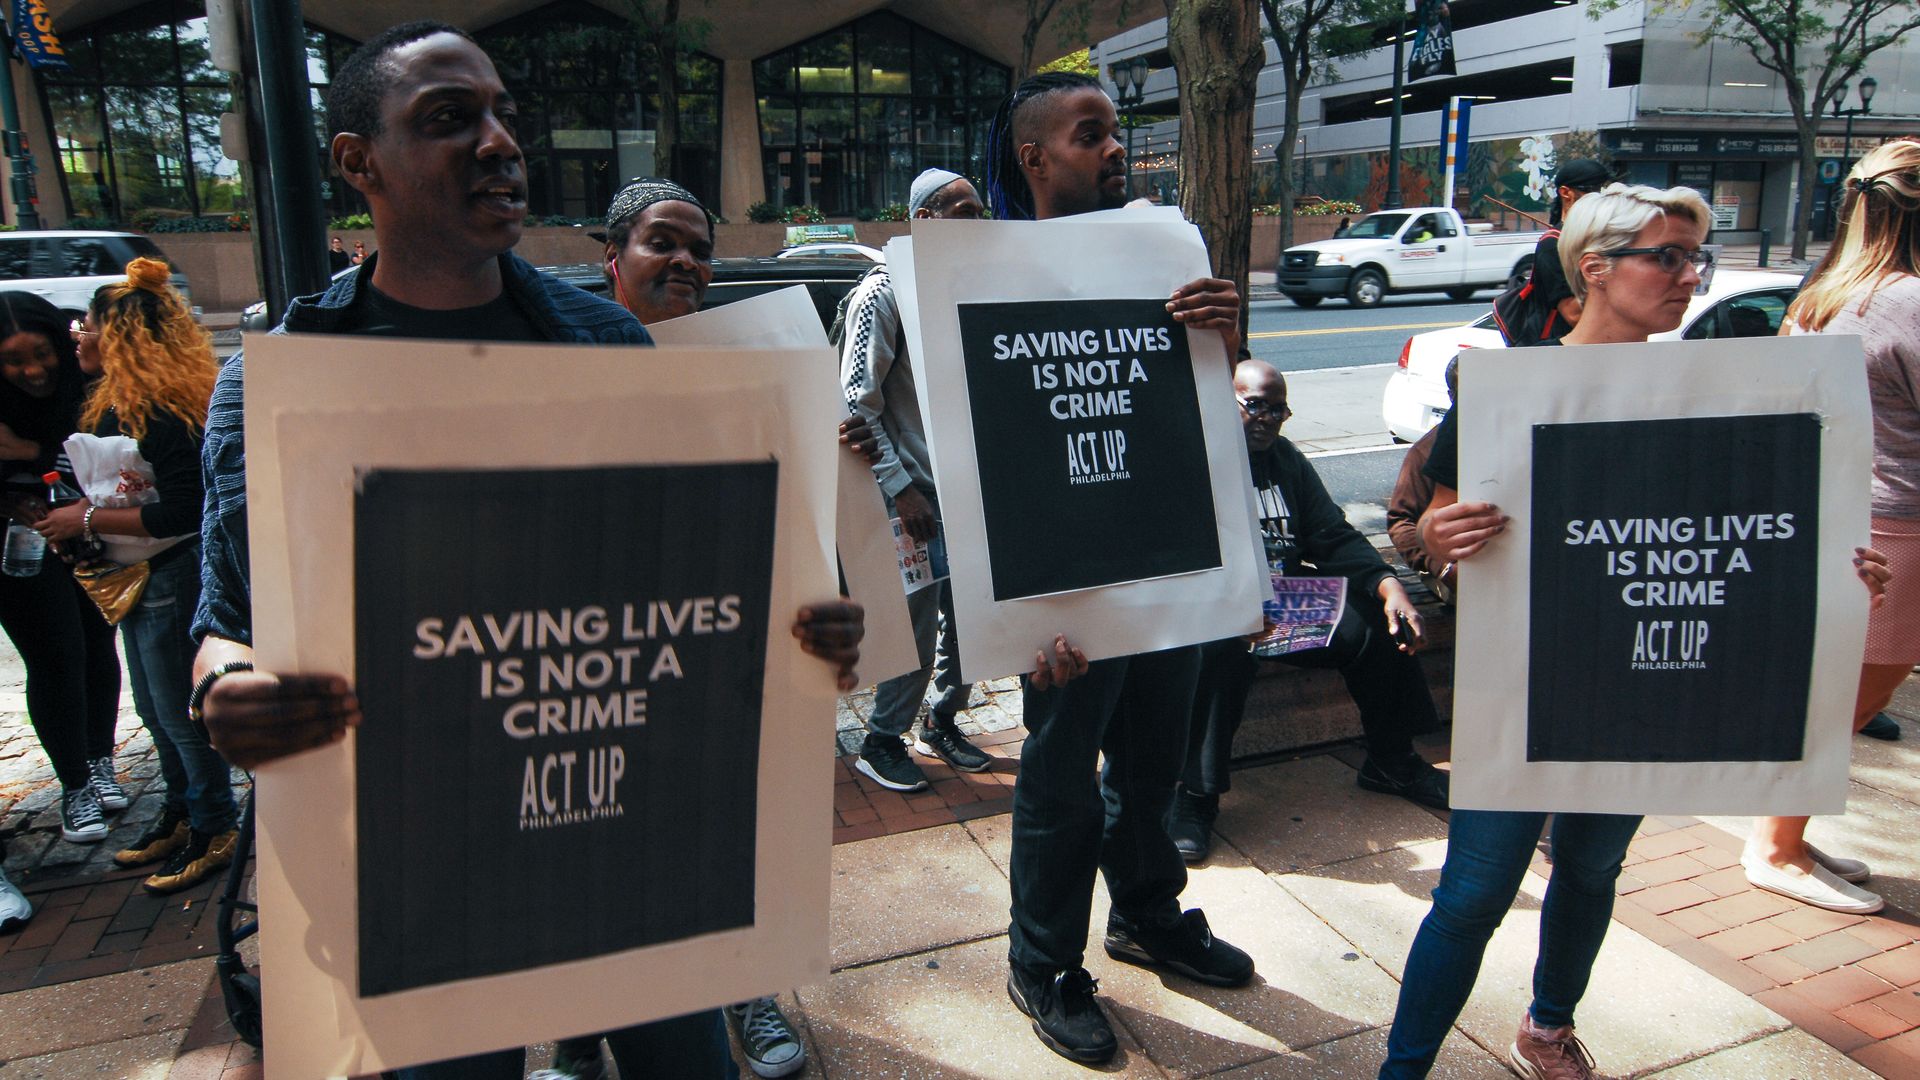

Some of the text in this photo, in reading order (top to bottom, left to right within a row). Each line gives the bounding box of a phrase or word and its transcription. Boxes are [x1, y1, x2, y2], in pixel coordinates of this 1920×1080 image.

[994, 327, 1172, 360] SAVING LIVES
[1032, 358, 1148, 390] IS NOT A
[1050, 389, 1132, 420] CRIME
[1067, 429, 1126, 476] ACT UP
[1070, 471, 1131, 485] PHILADELPHIA
[1564, 513, 1796, 545] SAVING LIVES
[1607, 547, 1752, 576] IS NOT A
[1621, 580, 1725, 607] CRIME
[413, 595, 741, 659] SAVING LIVES
[1632, 620, 1709, 661] ACT UP
[480, 643, 683, 699] IS NOT A
[1631, 661, 1707, 670] PHILADELPHIA
[502, 689, 648, 740] CRIME
[520, 745, 625, 817] ACT UP
[519, 803, 624, 831] PHILADELPHIA
